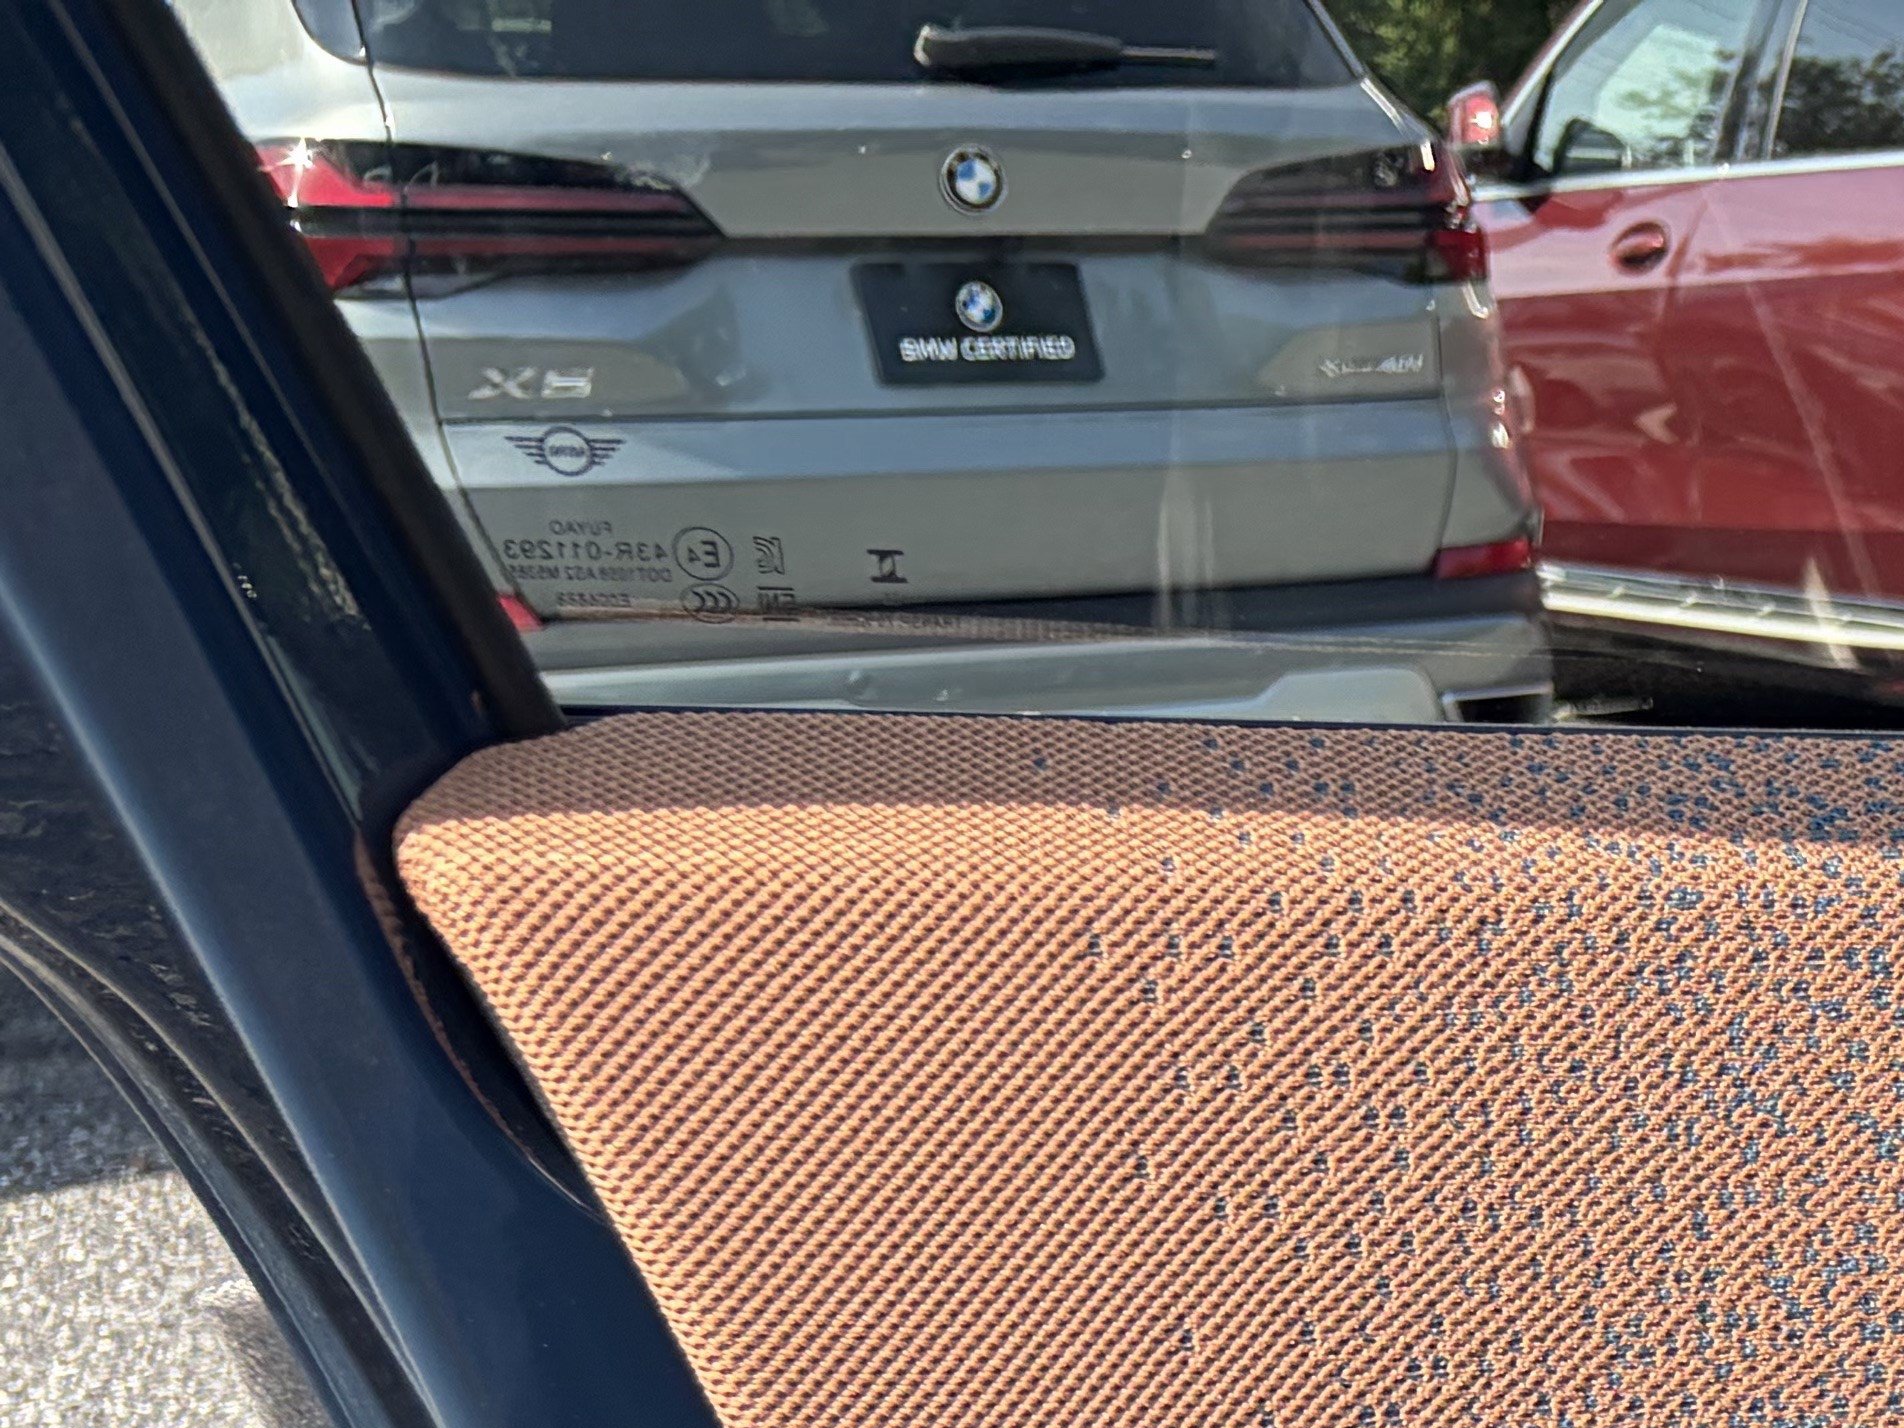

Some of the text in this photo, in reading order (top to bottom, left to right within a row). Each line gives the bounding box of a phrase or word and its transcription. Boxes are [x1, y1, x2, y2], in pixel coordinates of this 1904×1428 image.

[900, 335, 1075, 361] BMW CERTIFIED
[468, 366, 594, 399] X5
